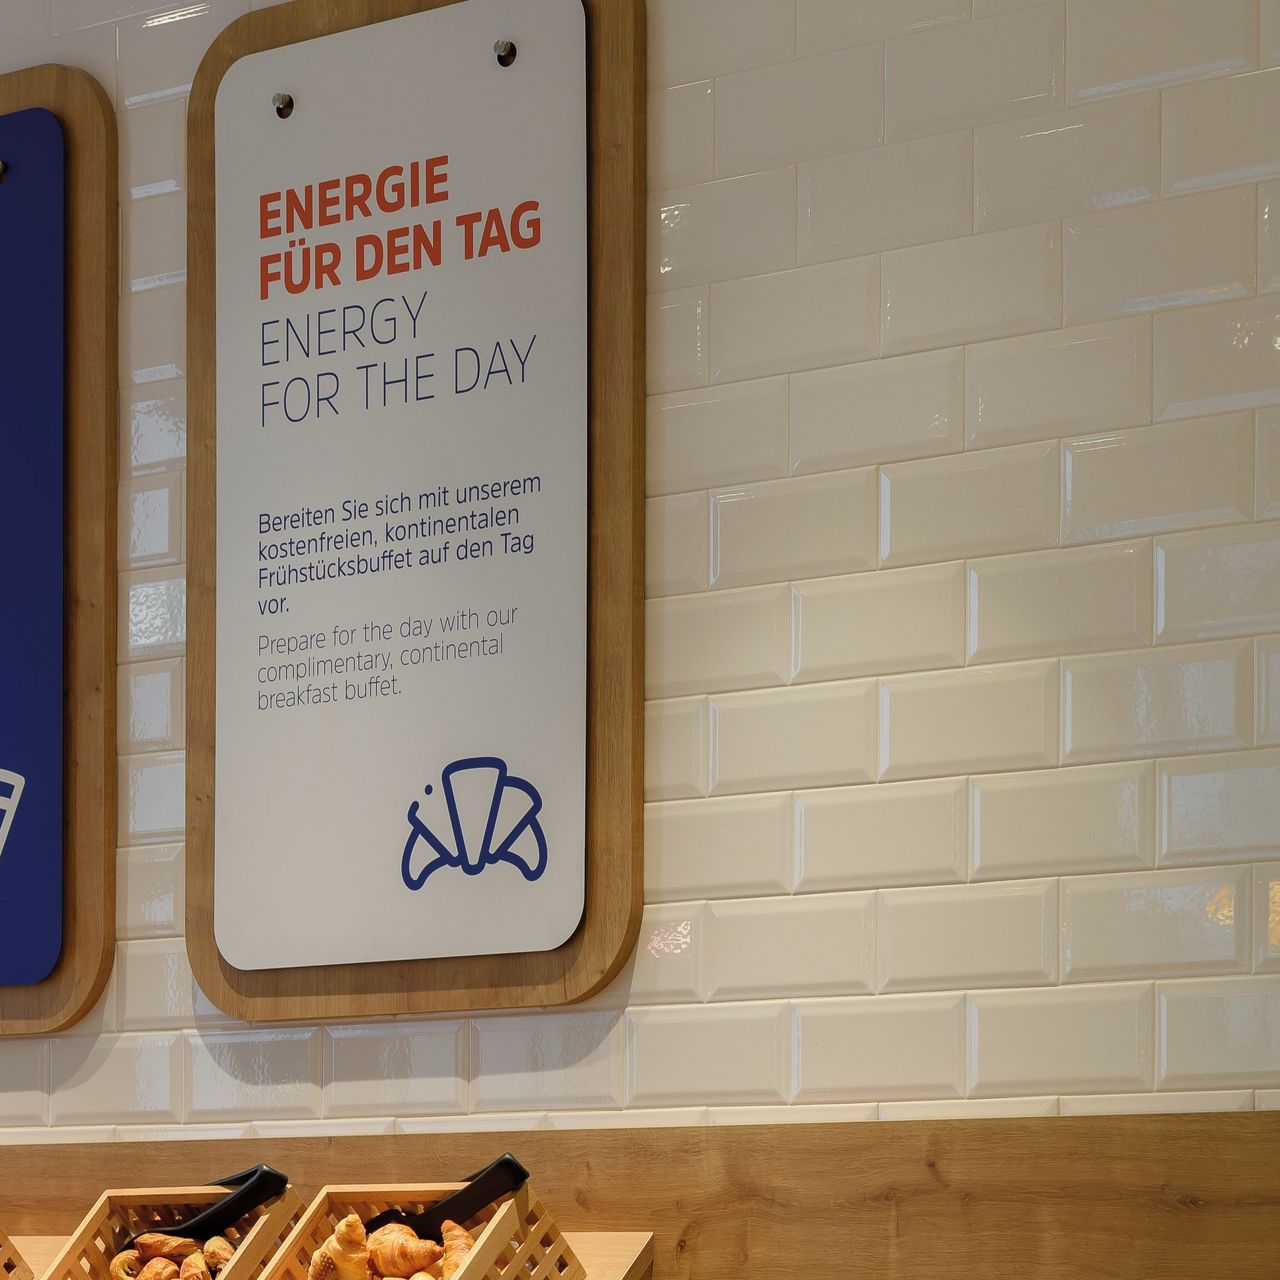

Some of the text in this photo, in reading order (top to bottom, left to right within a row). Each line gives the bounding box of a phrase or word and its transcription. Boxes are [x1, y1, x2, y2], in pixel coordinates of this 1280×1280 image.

[260, 155, 448, 239] ENERGIE
[260, 201, 540, 300] FÜR DEN TAG
[262, 291, 427, 366] ENERGY
[262, 335, 536, 427] FOR THE DAY
[259, 476, 540, 534] Bereiten Sie sich mit unserem
[259, 507, 518, 561] kostenfreien, kontinentalen
[259, 533, 533, 588] Frühstücksbuffet auf den Tag
[257, 596, 290, 616] vor.
[259, 608, 518, 656] Prepare for the day with our
[258, 633, 502, 683] complimentary, continental
[258, 675, 401, 711] breakfast buffet.
